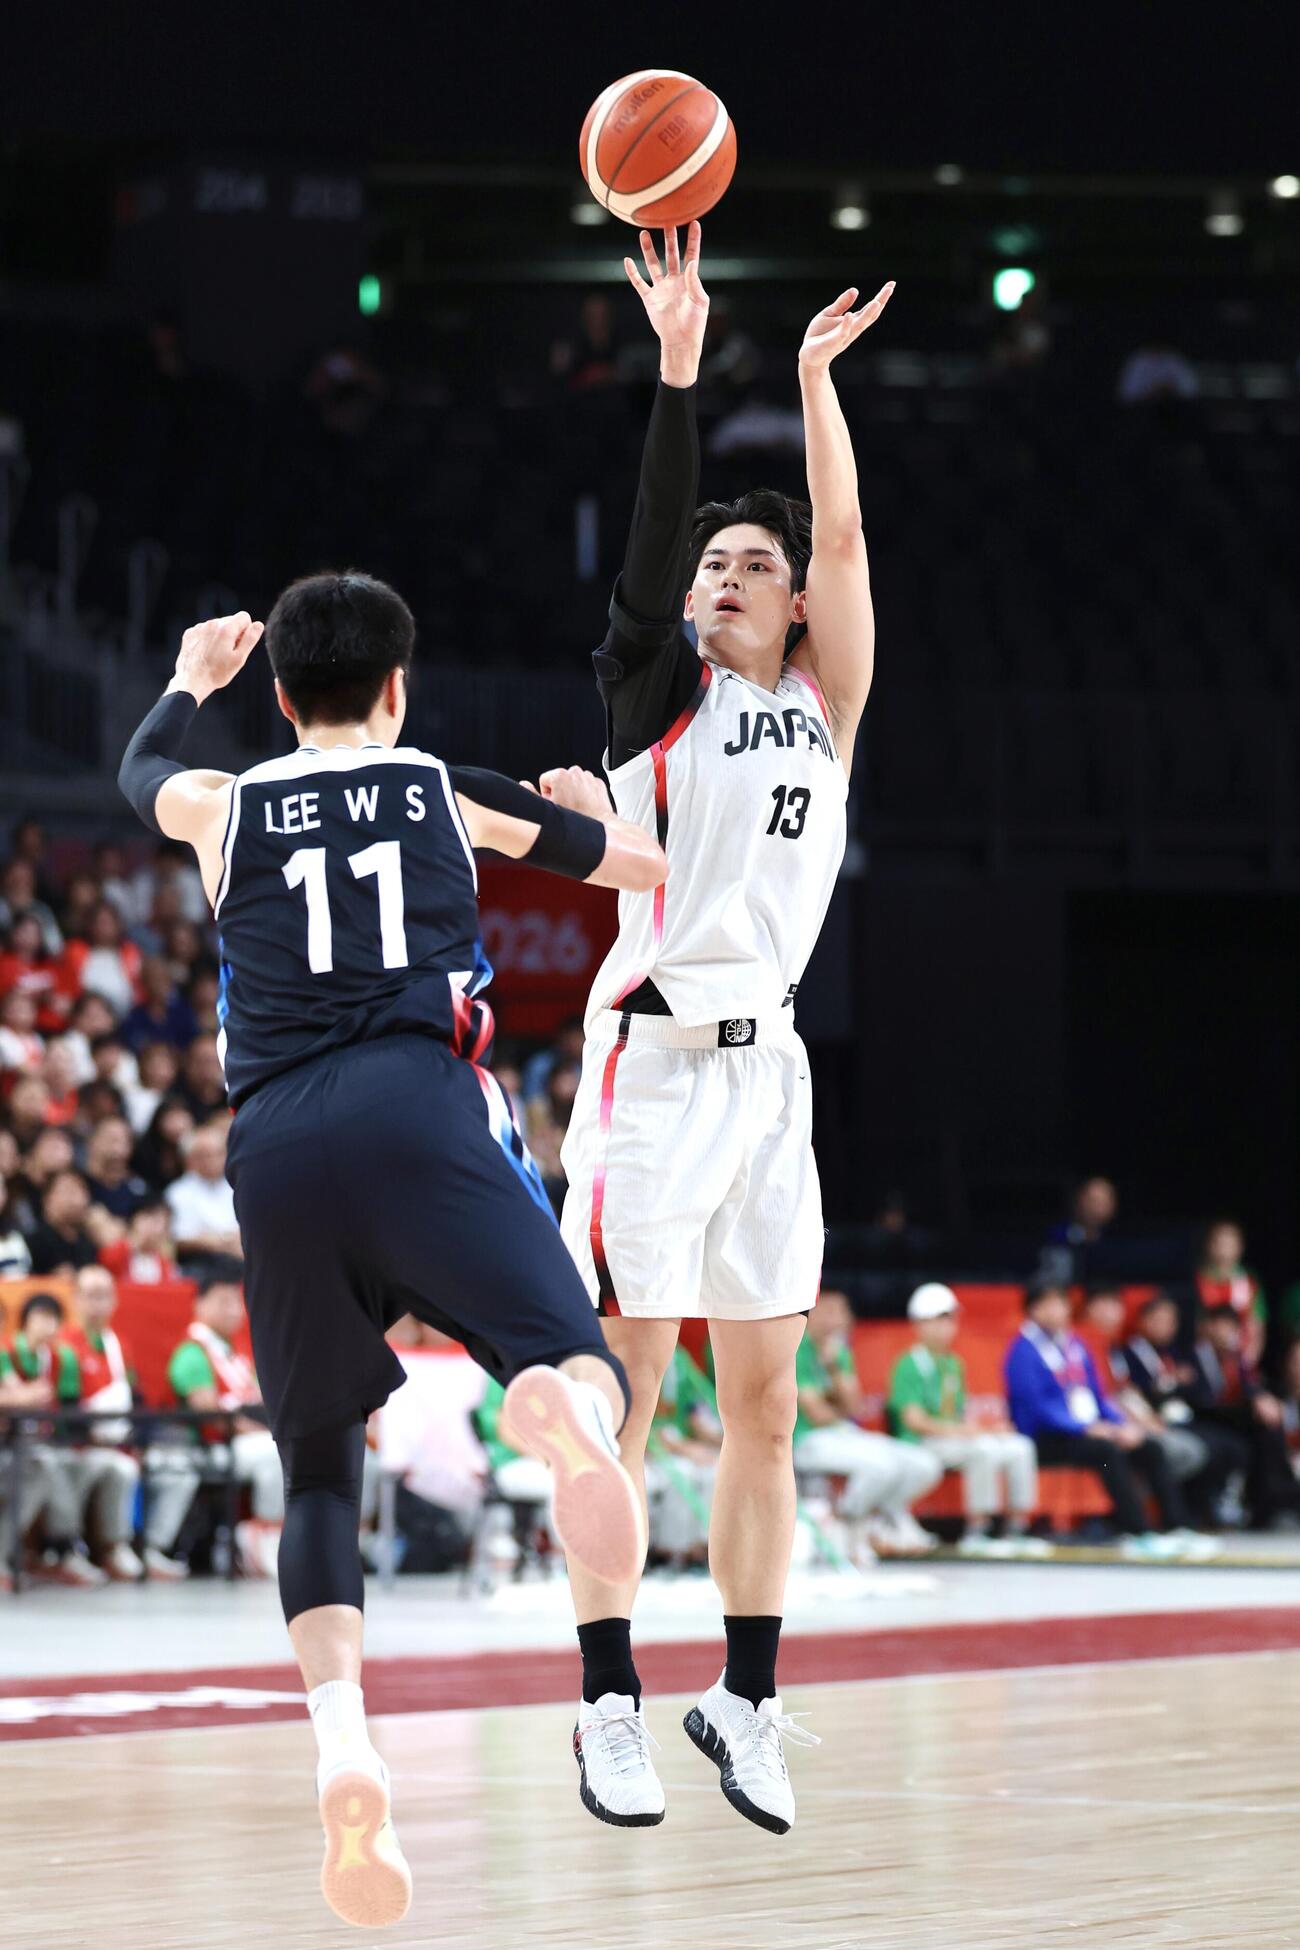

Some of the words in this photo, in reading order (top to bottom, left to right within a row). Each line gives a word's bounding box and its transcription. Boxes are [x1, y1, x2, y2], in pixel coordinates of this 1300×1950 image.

[614, 81, 664, 134] molten
[658, 115, 689, 146] FIBA
[264, 791, 321, 834] LEE
[343, 784, 379, 822] W
[405, 784, 427, 822] S
[766, 784, 812, 840] 13
[281, 840, 408, 974] 11
